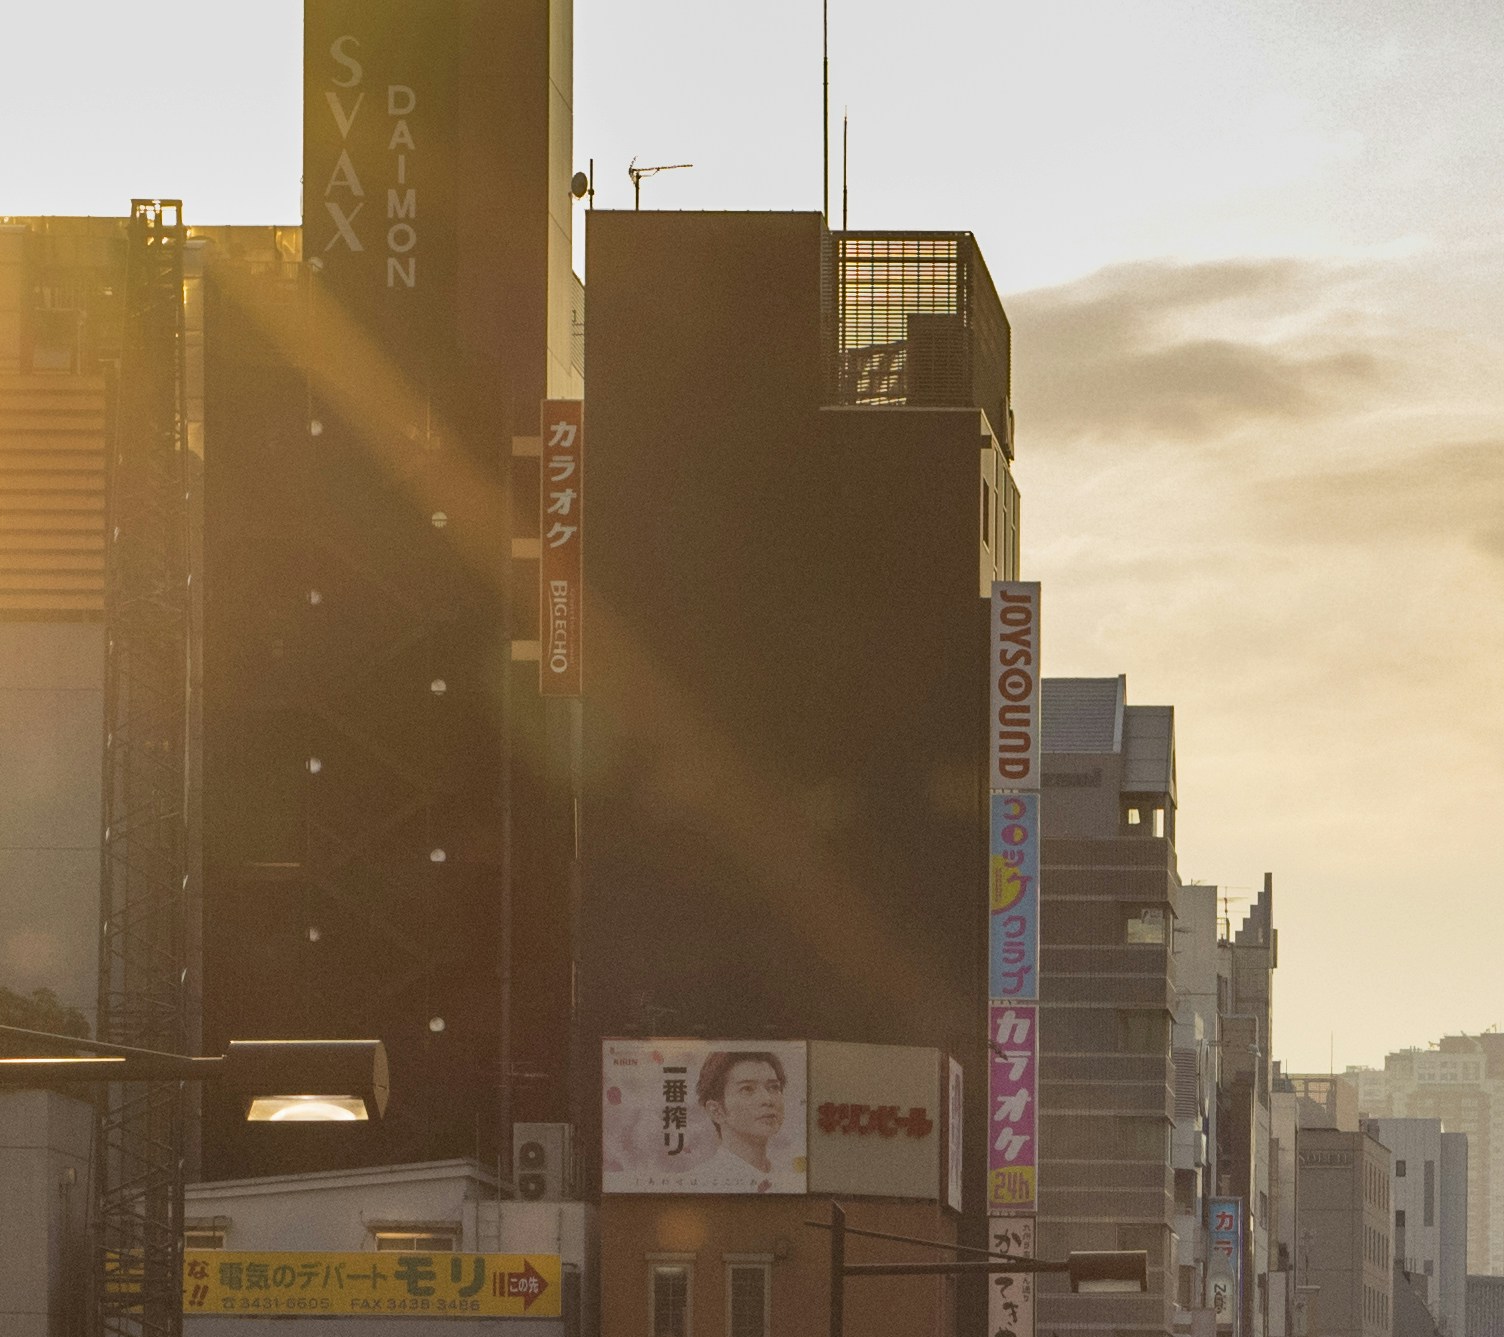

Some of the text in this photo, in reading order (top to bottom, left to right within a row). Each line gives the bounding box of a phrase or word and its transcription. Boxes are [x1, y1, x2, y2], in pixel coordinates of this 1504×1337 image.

[324, 35, 365, 253] SVAX
[386, 85, 417, 288] DAIMON
[547, 420, 578, 549] カラオケ
[998, 589, 1034, 781] JOYSOUND
[662, 1066, 687, 1156] 一番搾り
[993, 1009, 1033, 1162] カラオケ
[219, 1254, 486, 1298] 電気のデパート モリ
[350, 1299, 382, 1311] FAX
[507, 1274, 539, 1294] この先
